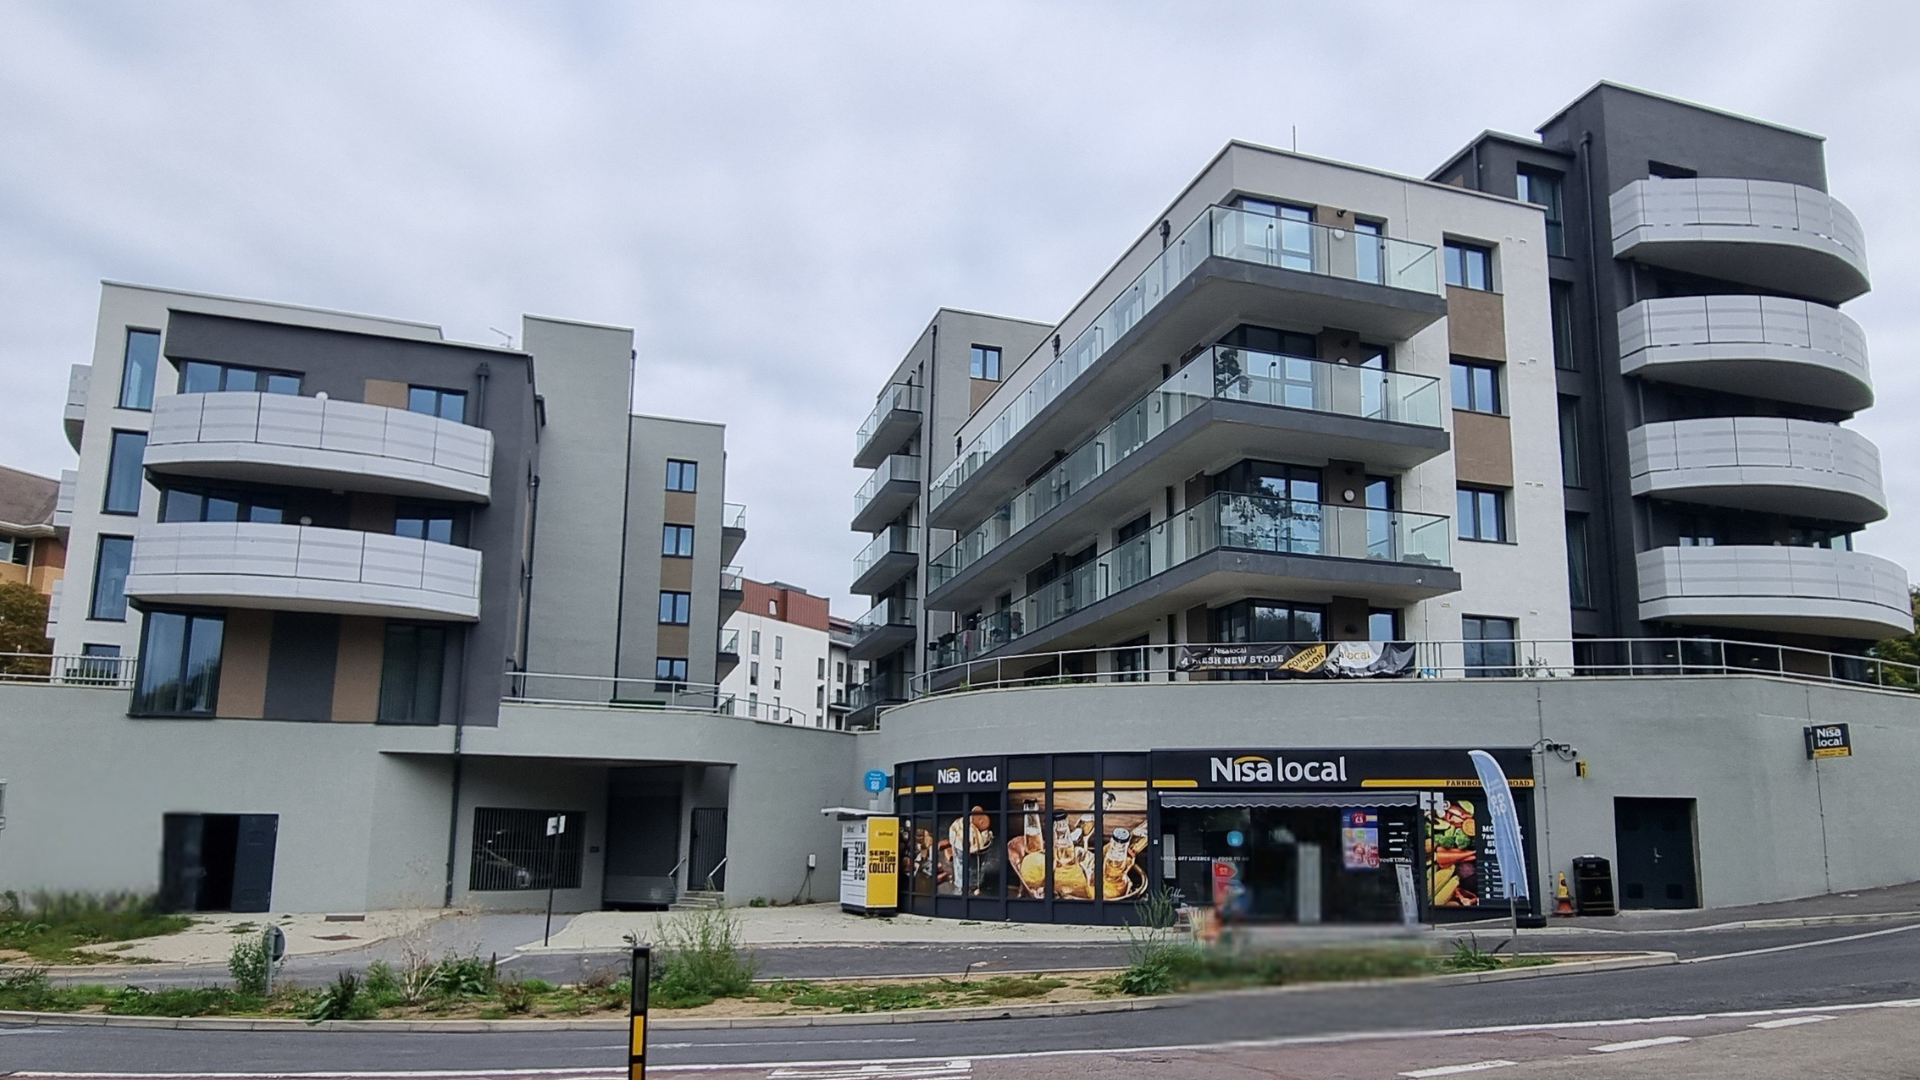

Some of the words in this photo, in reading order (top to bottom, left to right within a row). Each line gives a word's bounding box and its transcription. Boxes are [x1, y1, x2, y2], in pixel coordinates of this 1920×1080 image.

[1224, 656, 1247, 664] NEW
[1250, 654, 1284, 663] STORE
[1287, 646, 1318, 670] COMING
[1302, 652, 1325, 671] SOON
[1817, 726, 1842, 738] Nisa
[1817, 736, 1843, 747] local
[937, 767, 961, 785] Nisa
[967, 766, 998, 783] local
[869, 862, 896, 874] COLLECT
